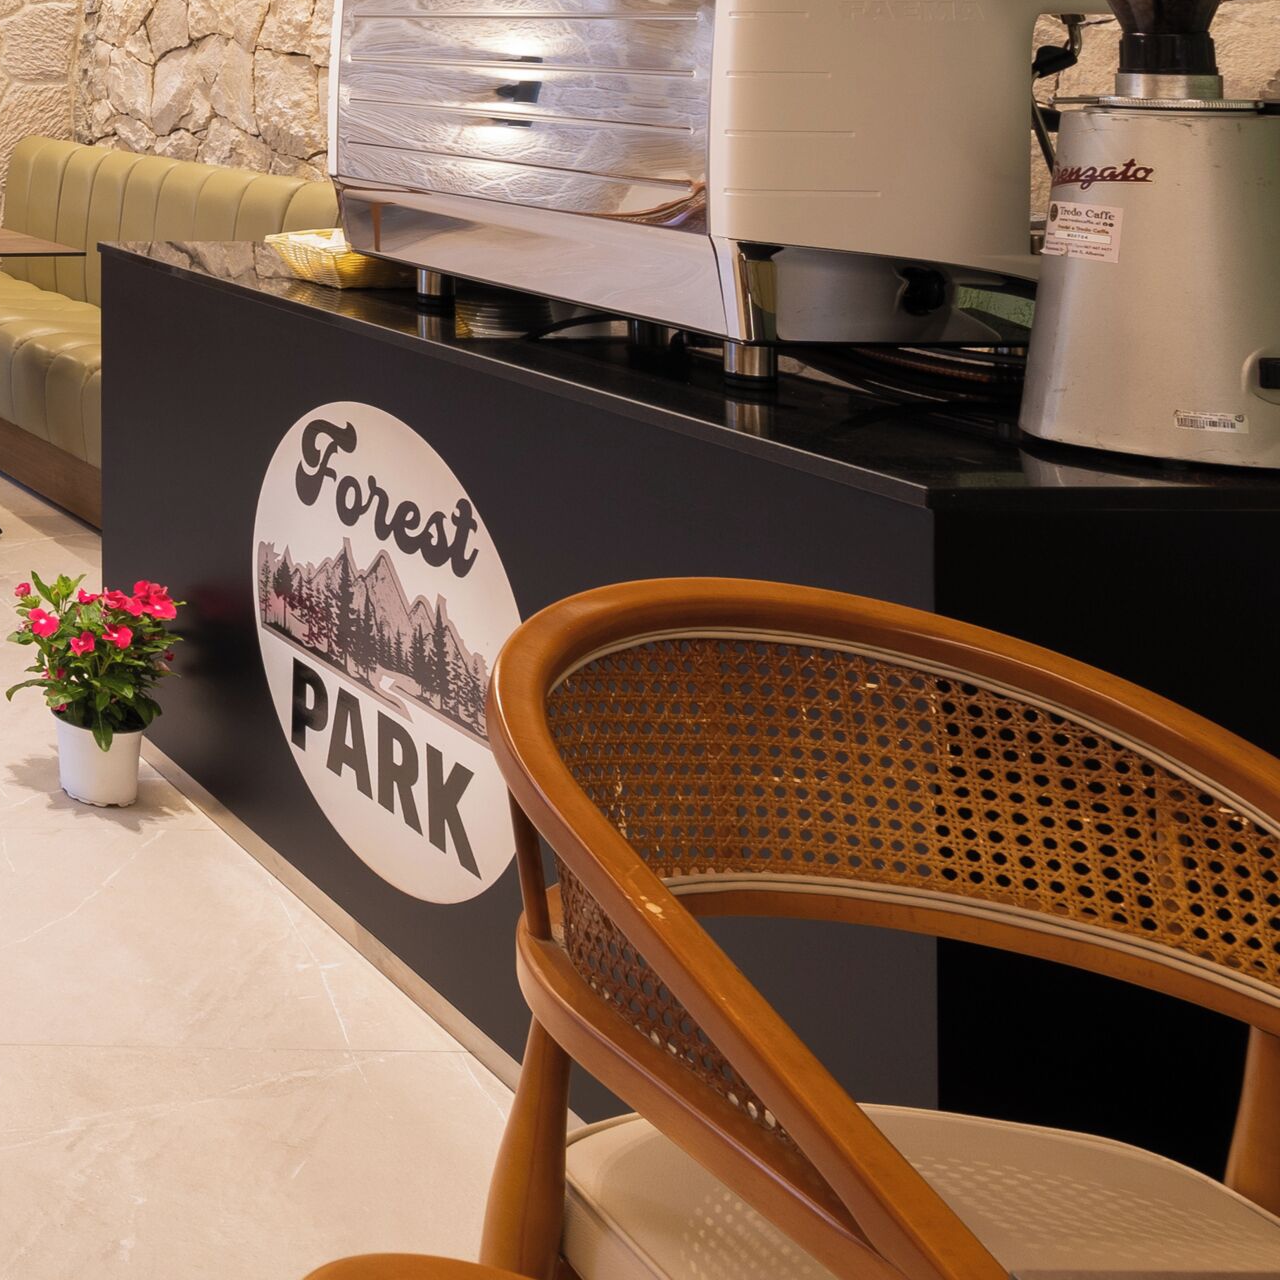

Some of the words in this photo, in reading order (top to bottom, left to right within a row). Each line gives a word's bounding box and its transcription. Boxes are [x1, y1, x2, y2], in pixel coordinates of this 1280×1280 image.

[840, 0, 985, 21] FAEMA
[295, 419, 479, 579] Forest
[291, 657, 482, 880] PARK
